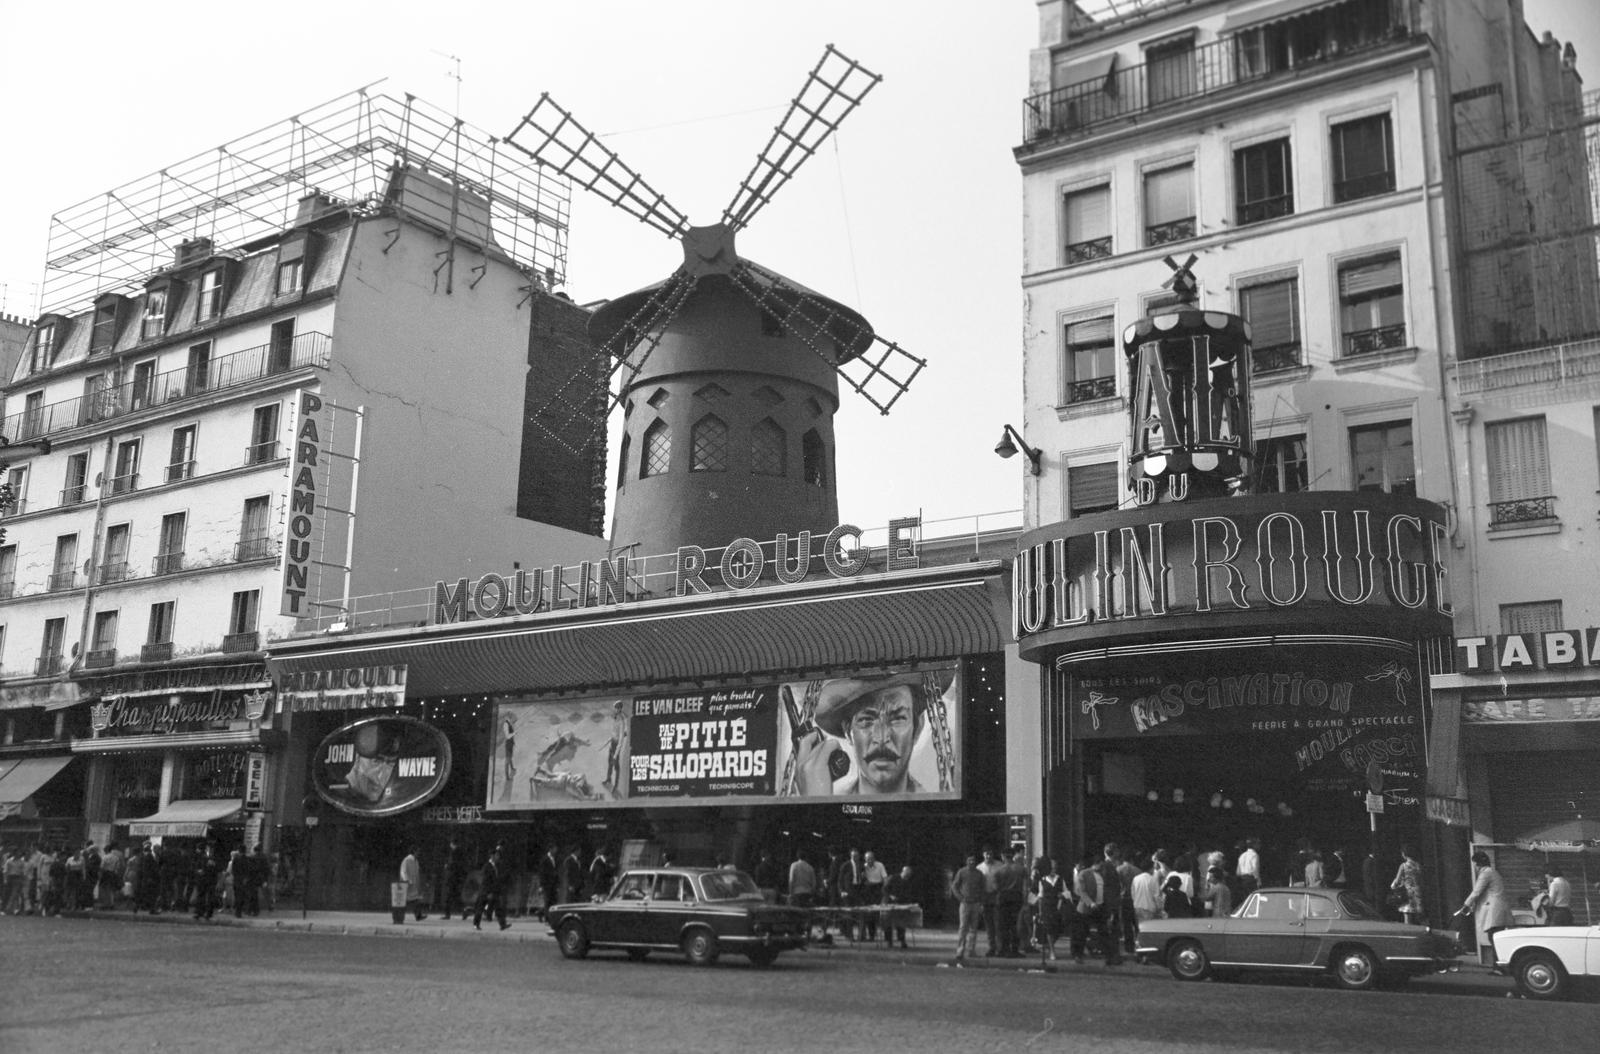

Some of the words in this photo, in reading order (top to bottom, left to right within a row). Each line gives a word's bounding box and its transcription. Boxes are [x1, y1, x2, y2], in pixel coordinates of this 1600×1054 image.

[1136, 472, 1188, 506] DU
[285, 392, 322, 613] PARAMOUNT
[434, 556, 631, 625] MOULIN
[675, 517, 920, 597] ROUGE
[635, 700, 650, 716] LEE
[652, 699, 673, 715] VAN
[675, 696, 704, 714] CLEEF
[659, 723, 675, 738] PAS
[1308, 718, 1344, 728] GRAND
[1352, 715, 1415, 727] SPECTACLE
[324, 743, 354, 764] JOHN
[660, 737, 672, 750] DE
[398, 756, 437, 778] WAYNE
[630, 755, 650, 769] POUR
[649, 749, 768, 780] SALOPARDS
[251, 759, 263, 800] SELF
[632, 768, 647, 781] LES
